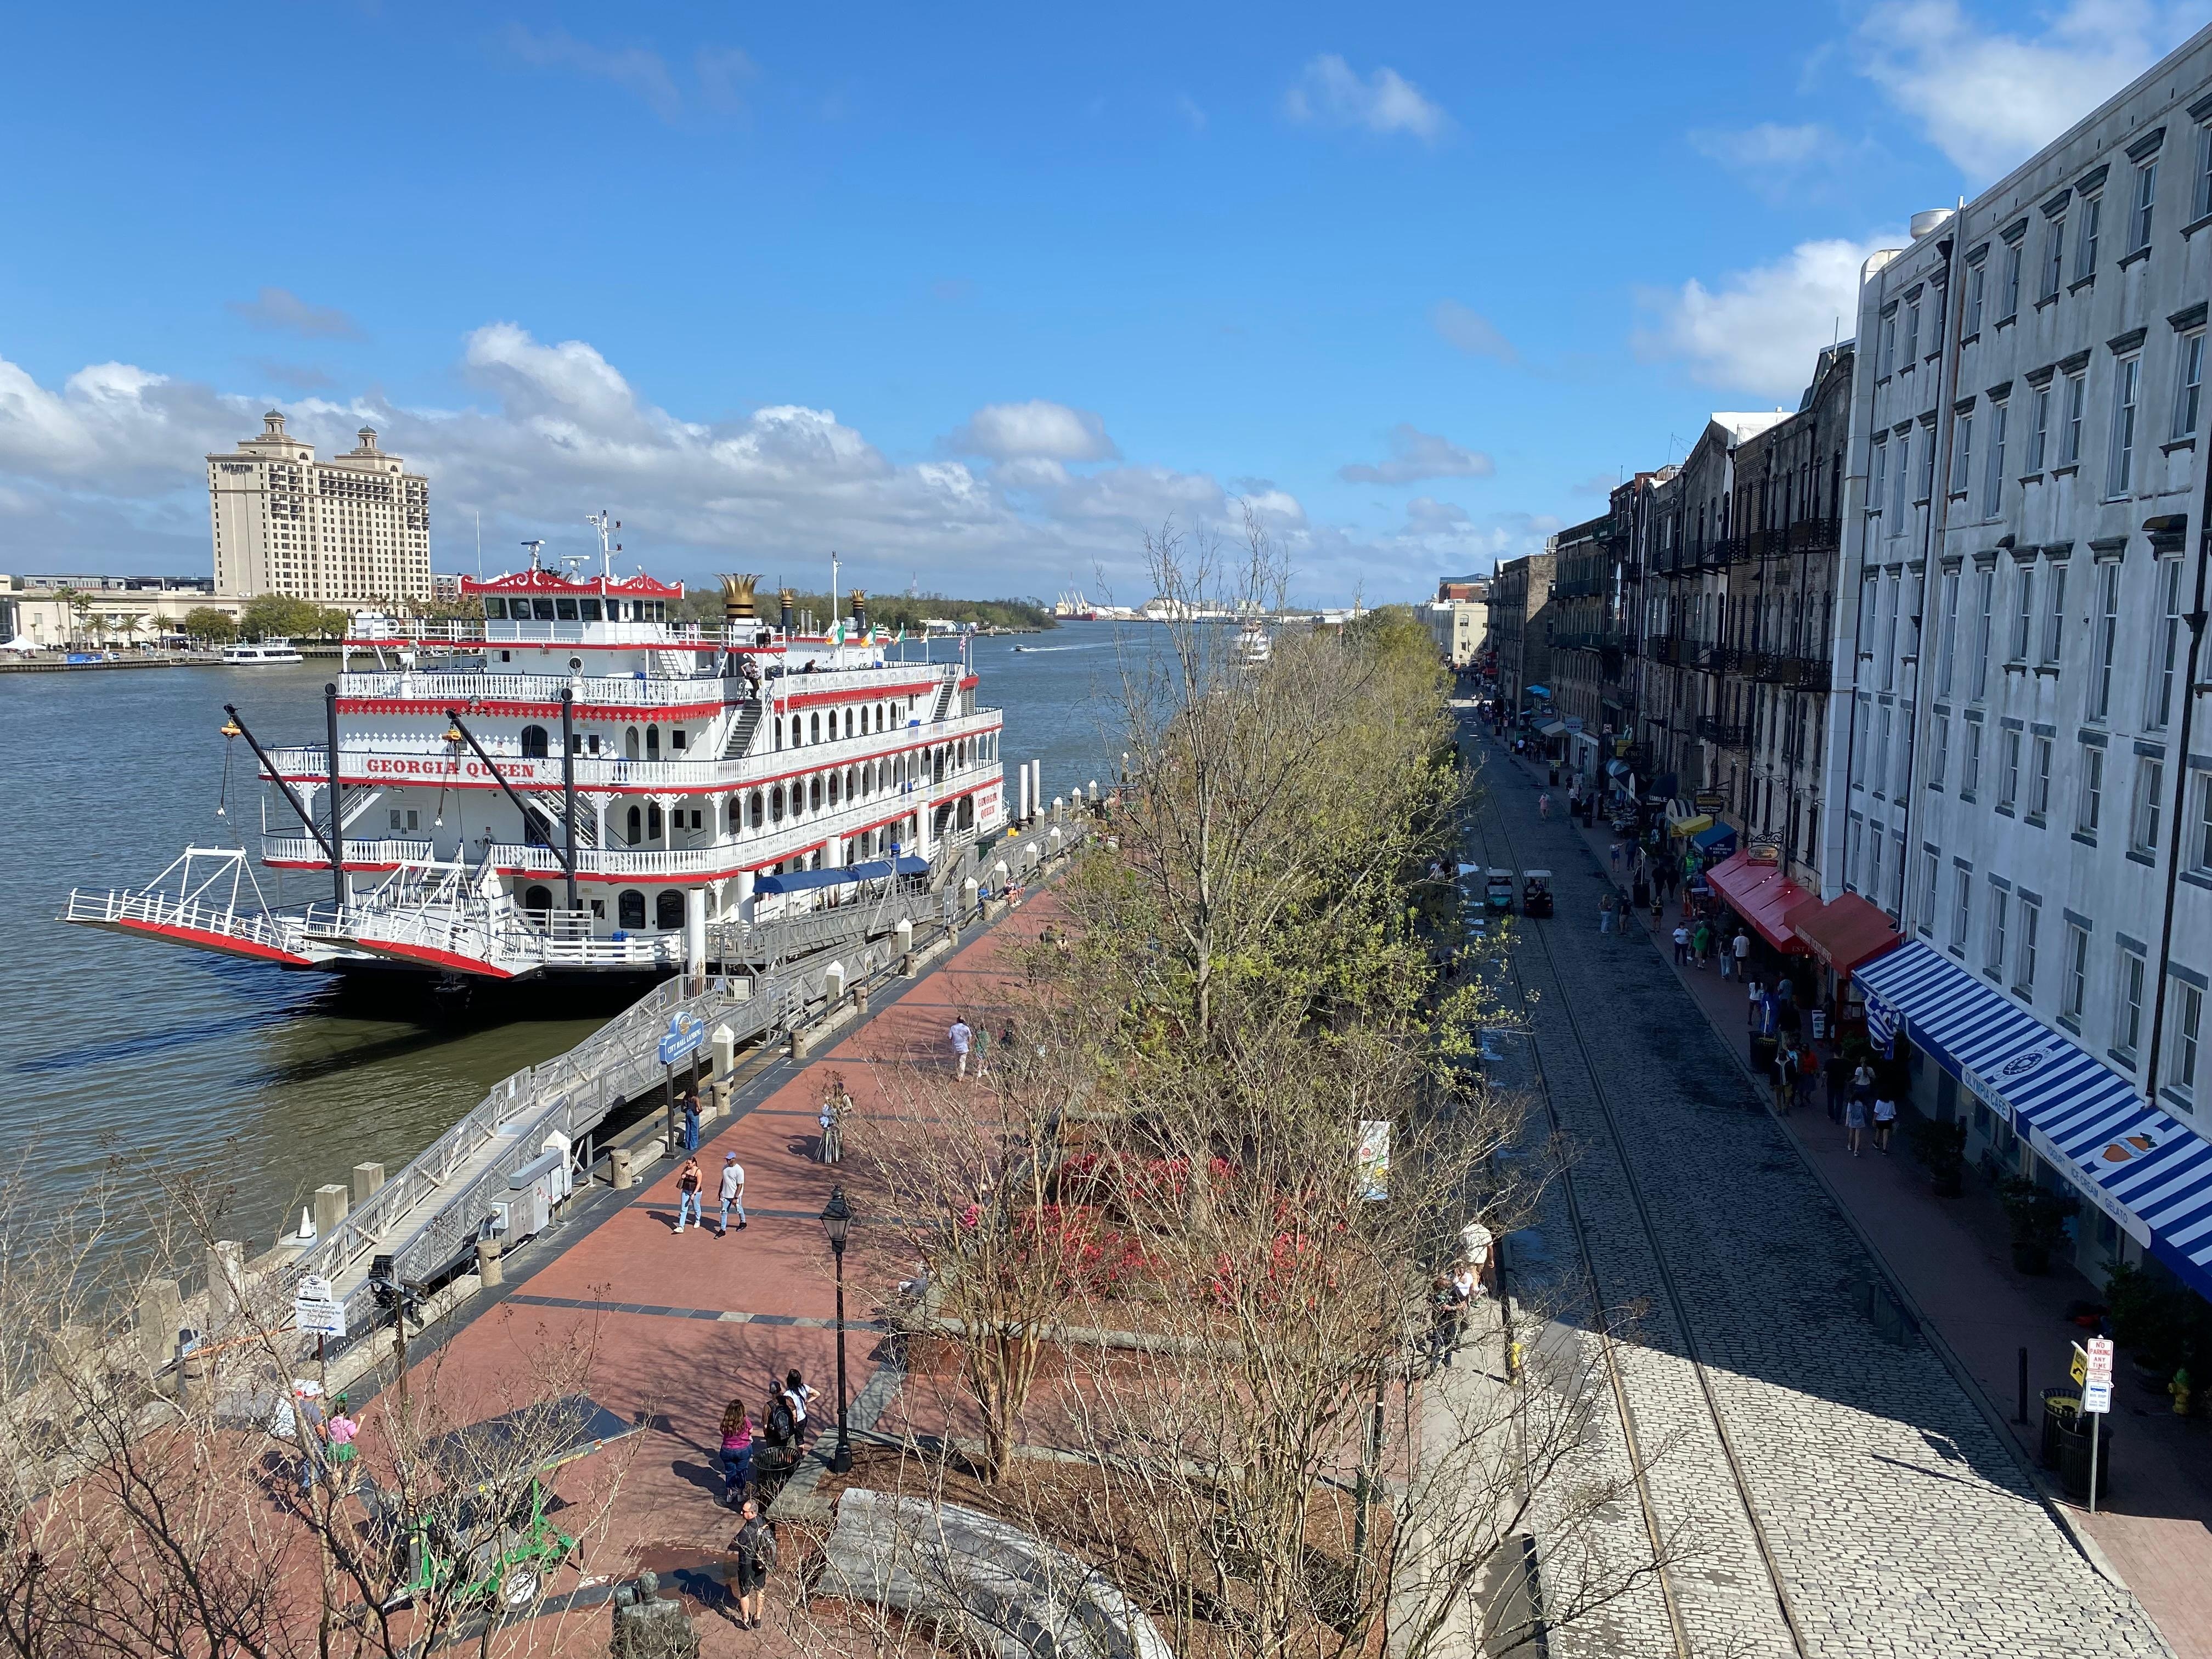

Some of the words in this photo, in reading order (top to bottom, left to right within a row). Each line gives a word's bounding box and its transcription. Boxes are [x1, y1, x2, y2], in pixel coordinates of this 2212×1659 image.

[366, 759, 460, 775] GEORGIA
[978, 792, 998, 808] GEORGIA
[981, 805, 995, 820] QUEEN
[668, 1043, 676, 1054] CITY
[676, 1037, 686, 1049] HALL
[686, 1028, 701, 1043] LANDING
[1965, 1072, 1990, 1099] OLYMPIA
[1990, 1093, 2006, 1116] CAFE
[2046, 1143, 2066, 1167] YOGURT
[2071, 1167, 2079, 1180] ICE
[2080, 1176, 2098, 1198] CREAM
[2105, 1198, 2128, 1223] GELATO
